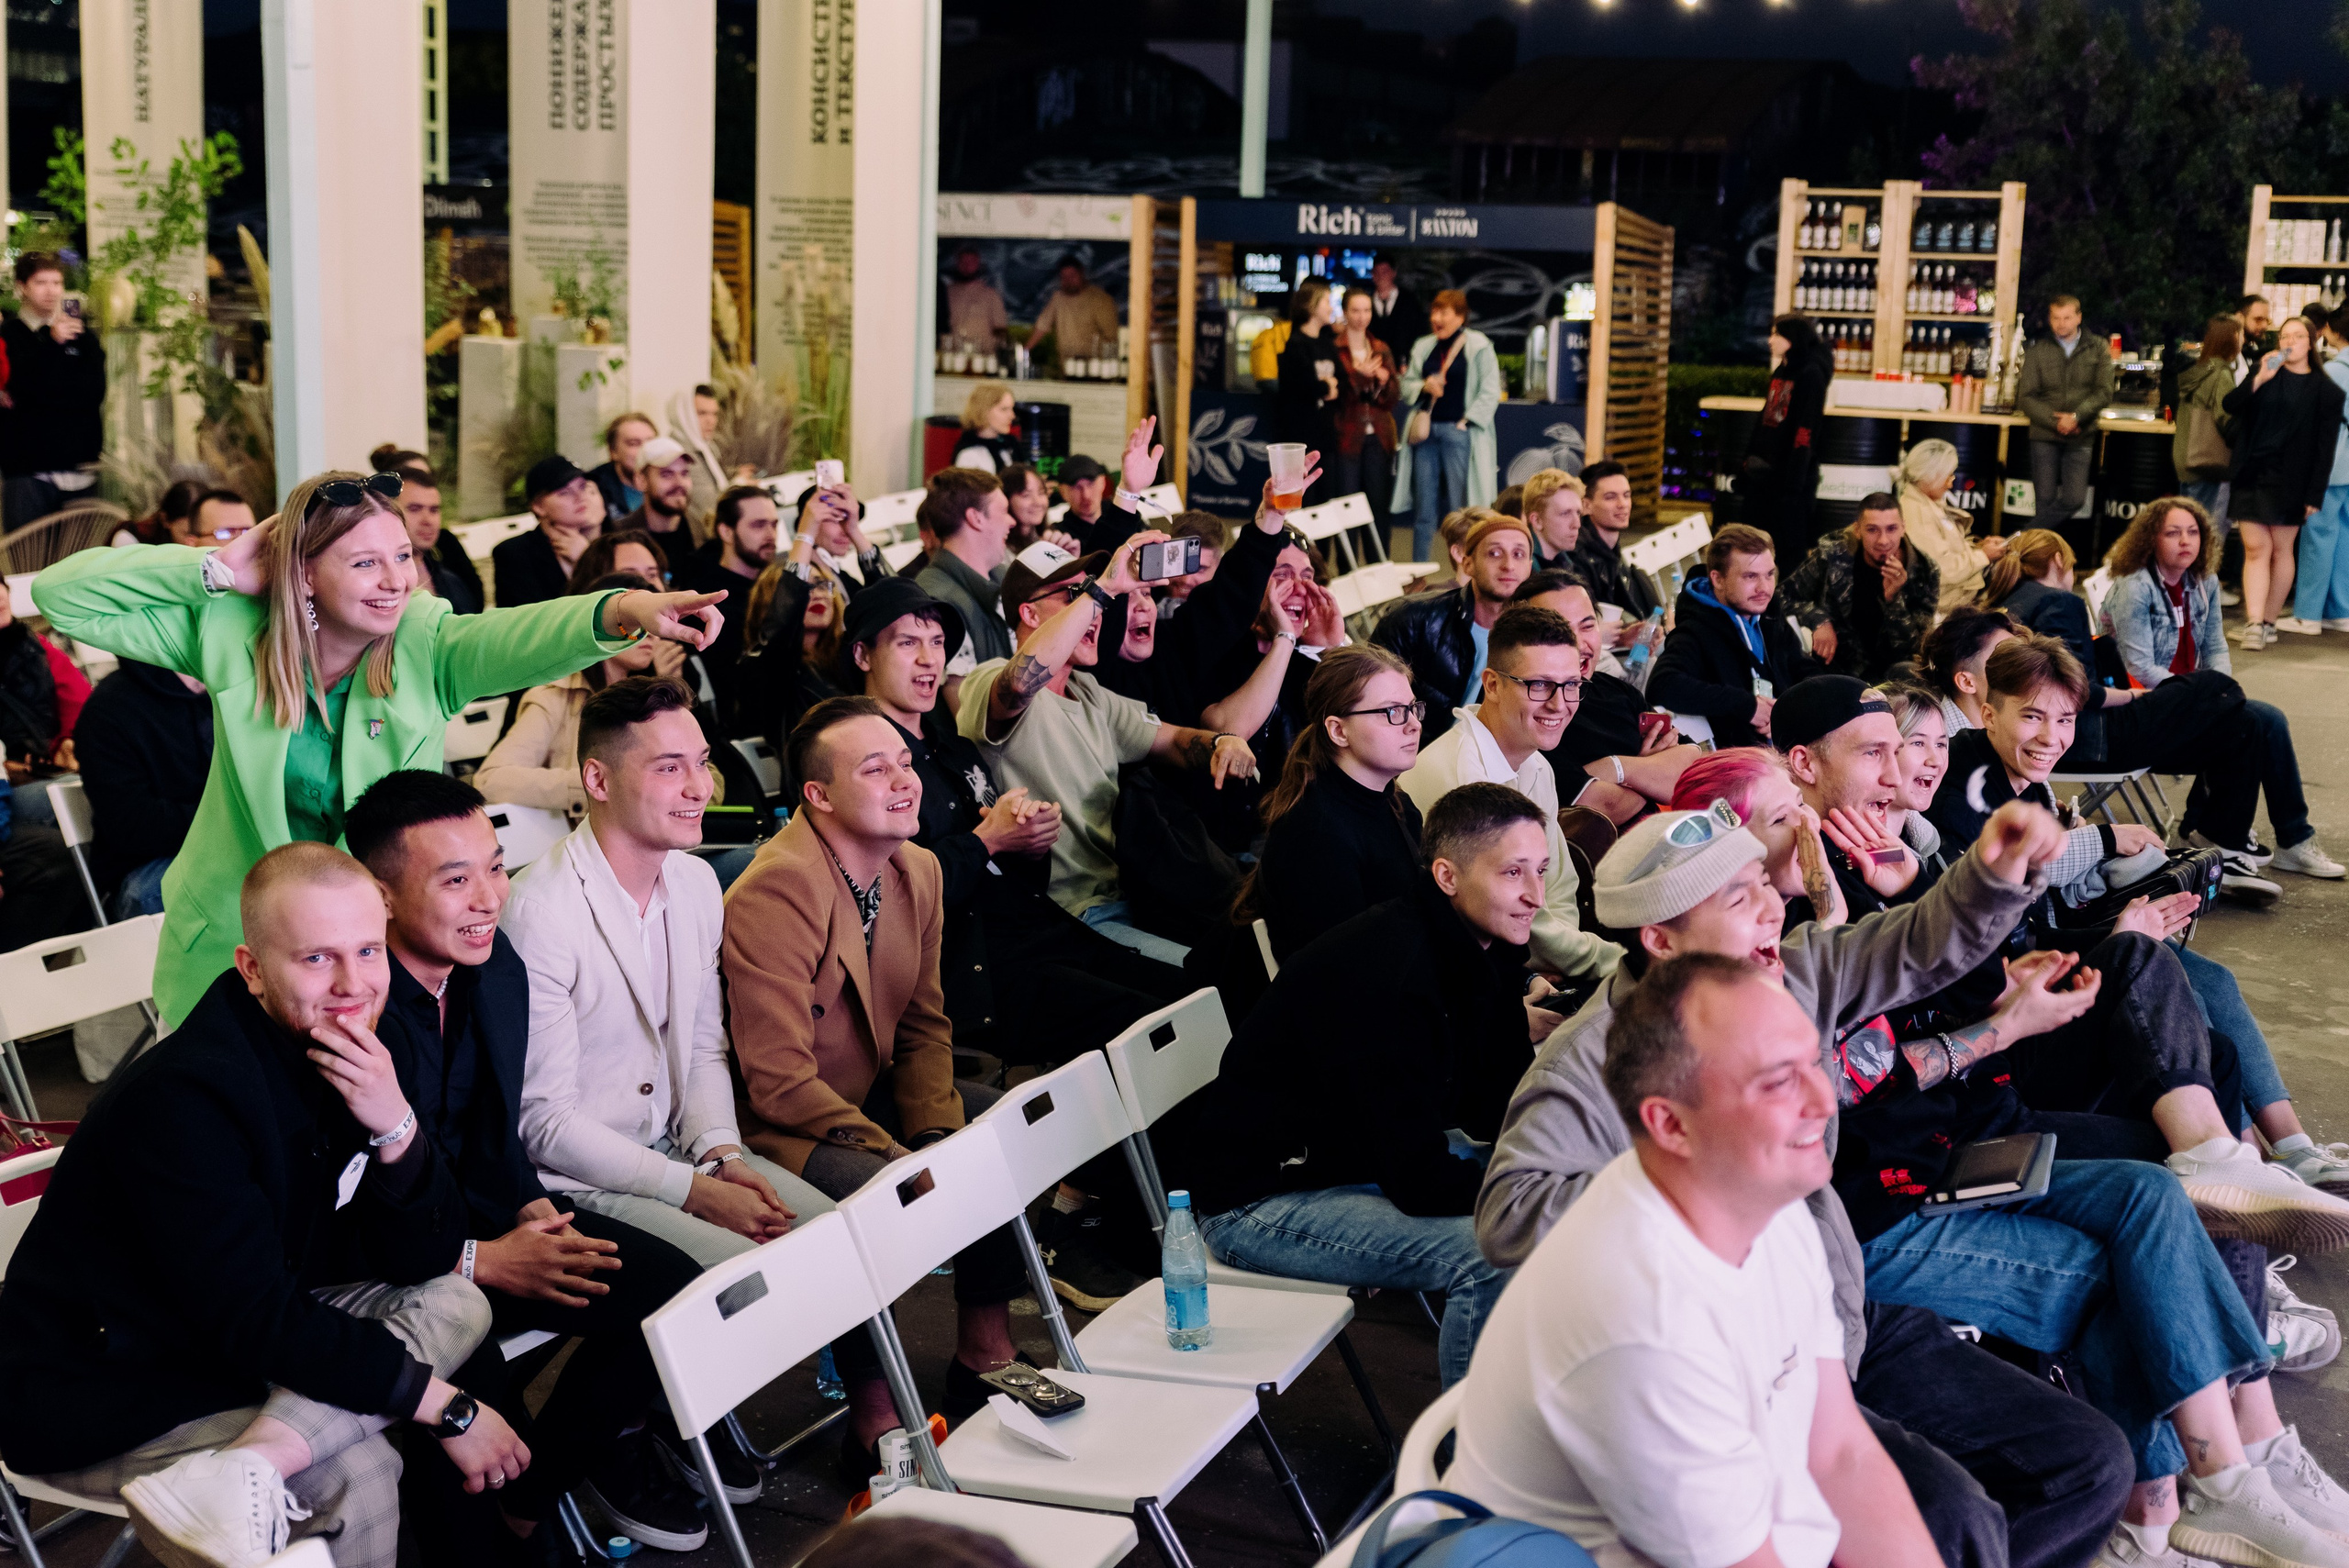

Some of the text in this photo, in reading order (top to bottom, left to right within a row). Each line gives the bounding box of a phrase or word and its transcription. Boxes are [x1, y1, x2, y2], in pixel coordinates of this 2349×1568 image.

[134, 0, 150, 123] НАТУРАЛ
[549, 0, 565, 129] ПОНИЖЕ
[1298, 203, 1362, 236] Rich
[1943, 490, 1987, 510] NIN
[403, 1111, 413, 1129] EXP
[465, 1240, 474, 1262] EXPO
[898, 1457, 918, 1479] SIM
